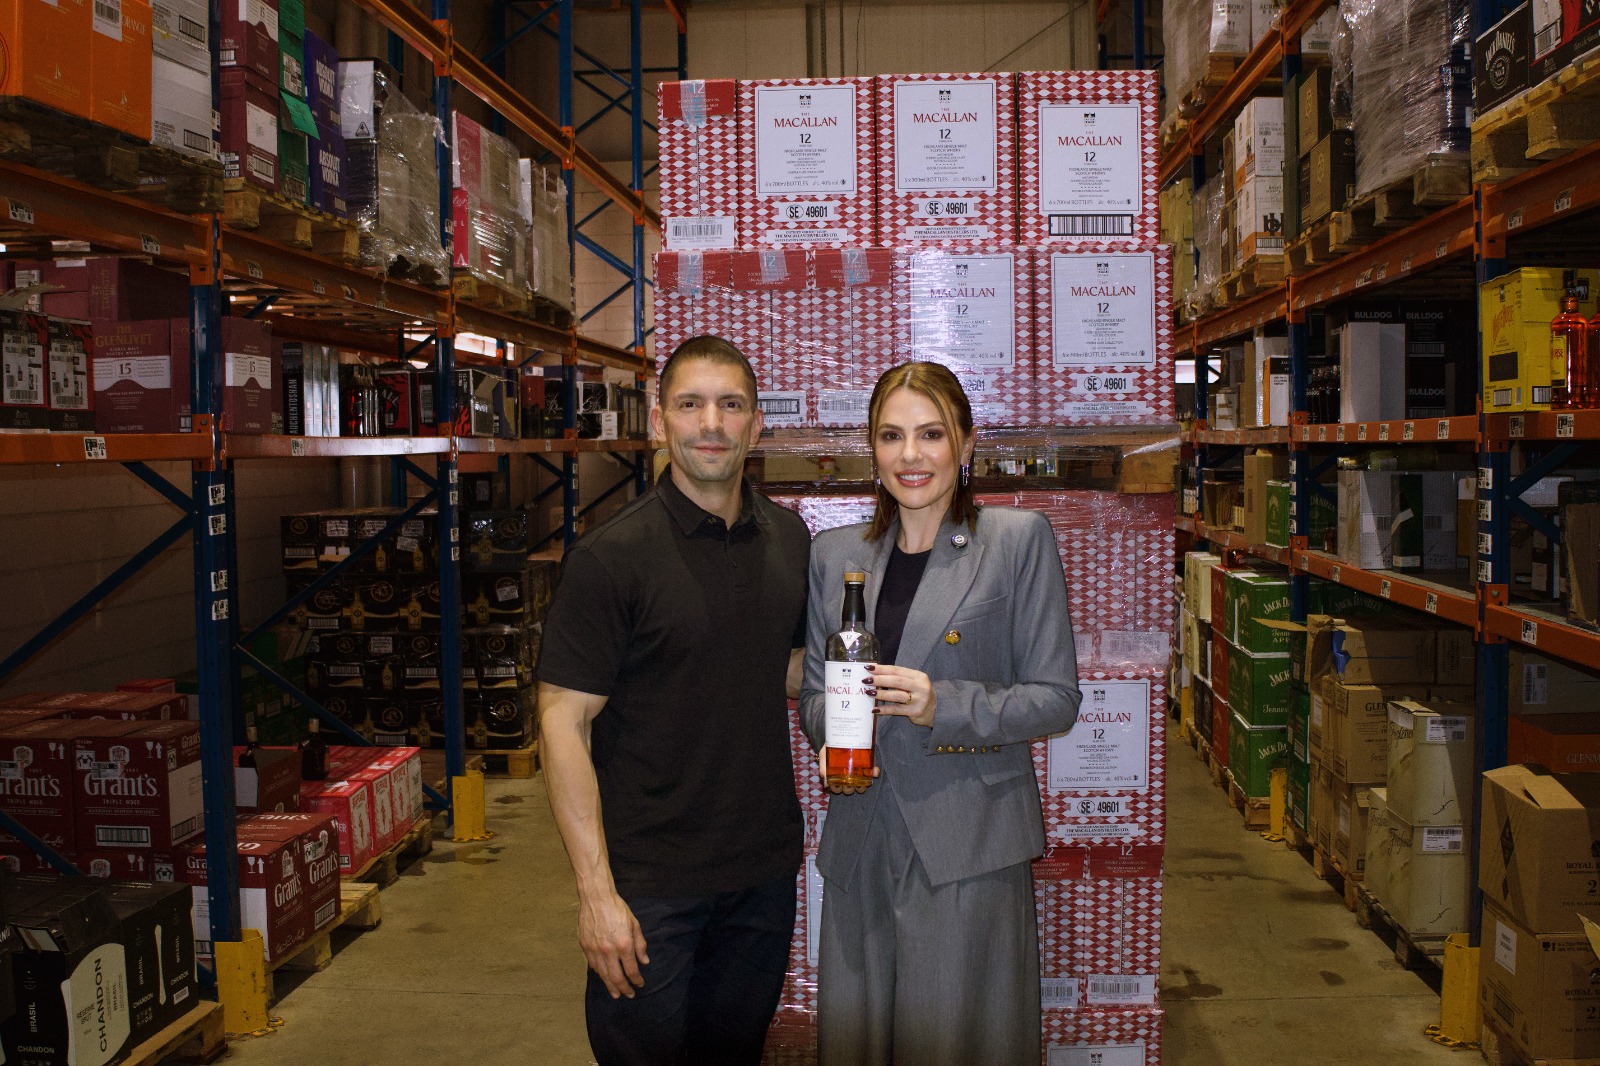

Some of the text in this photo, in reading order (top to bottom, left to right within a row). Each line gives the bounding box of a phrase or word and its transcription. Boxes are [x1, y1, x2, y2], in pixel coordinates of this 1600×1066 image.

[692, 83, 705, 94] 12
[774, 116, 837, 128] MACALLAN
[912, 112, 978, 123] MACALLAN
[800, 133, 812, 144] 12
[939, 128, 951, 140] 12
[1058, 135, 1122, 146] MACALLAN
[319, 149, 341, 173] ABSOLUT
[1084, 151, 1096, 163] 12
[321, 165, 340, 188] VODKA
[789, 205, 828, 218] SE 49601
[929, 202, 968, 215] SE 49601
[929, 287, 996, 299] MACALLAN
[1071, 285, 1137, 297] MACALLAN
[956, 304, 969, 315] 12
[1097, 302, 1110, 314] 12
[1354, 311, 1393, 320] BULLDOG
[1405, 312, 1444, 320] BULLDOG
[94, 334, 153, 348] GLENLIVET
[118, 362, 132, 375] 15
[1087, 377, 1127, 391] SE 49601
[1408, 388, 1446, 396] BULLDOG
[288, 378, 298, 435] AUCHENTOSHAN
[1264, 600, 1283, 615] JACK
[1268, 669, 1290, 687] JACK
[841, 700, 851, 710] 12
[1076, 712, 1132, 723] ACALLAN
[1092, 729, 1105, 739] 12
[1258, 744, 1277, 760] JACK
[0, 774, 61, 797] rant's
[83, 773, 158, 798] Grant's
[1081, 800, 1120, 814] SE 49601
[1120, 844, 1133, 856] 12
[310, 850, 339, 884] Grant's
[274, 871, 302, 908] Grant's
[1565, 988, 1592, 996] ROYAL
[94, 957, 108, 1053] CHANDON
[29, 1001, 38, 1033] BRASIL
[17, 1045, 55, 1054] CHANDON
